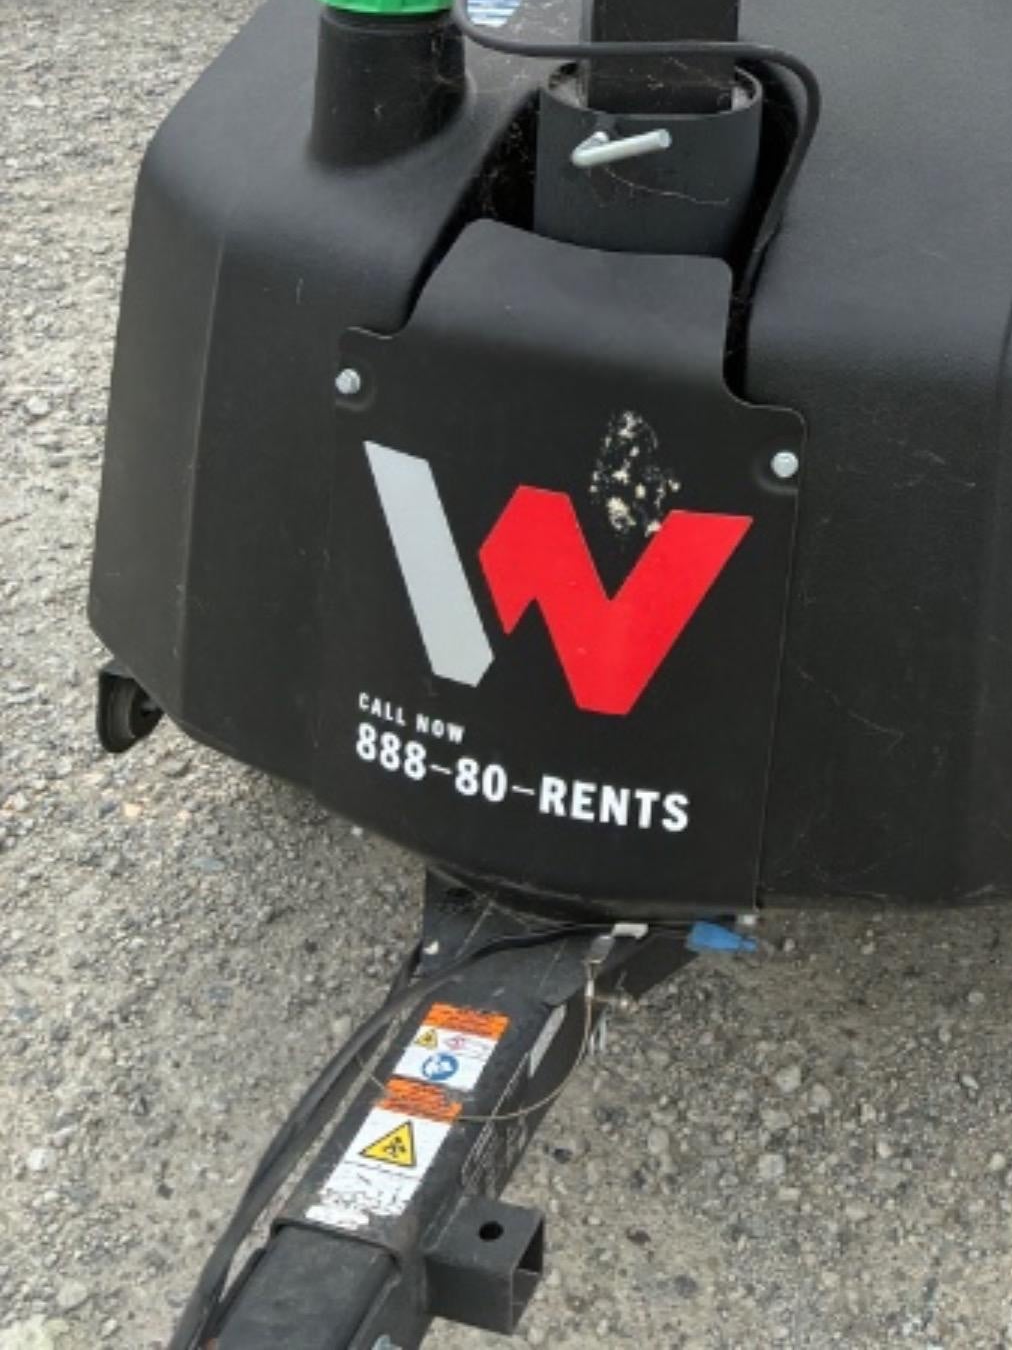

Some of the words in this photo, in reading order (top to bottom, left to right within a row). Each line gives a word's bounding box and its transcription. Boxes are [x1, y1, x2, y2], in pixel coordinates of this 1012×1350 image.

[358, 692, 406, 726] CALL
[416, 713, 466, 745] NOW
[355, 723, 691, 833] 888-80-RENTS
